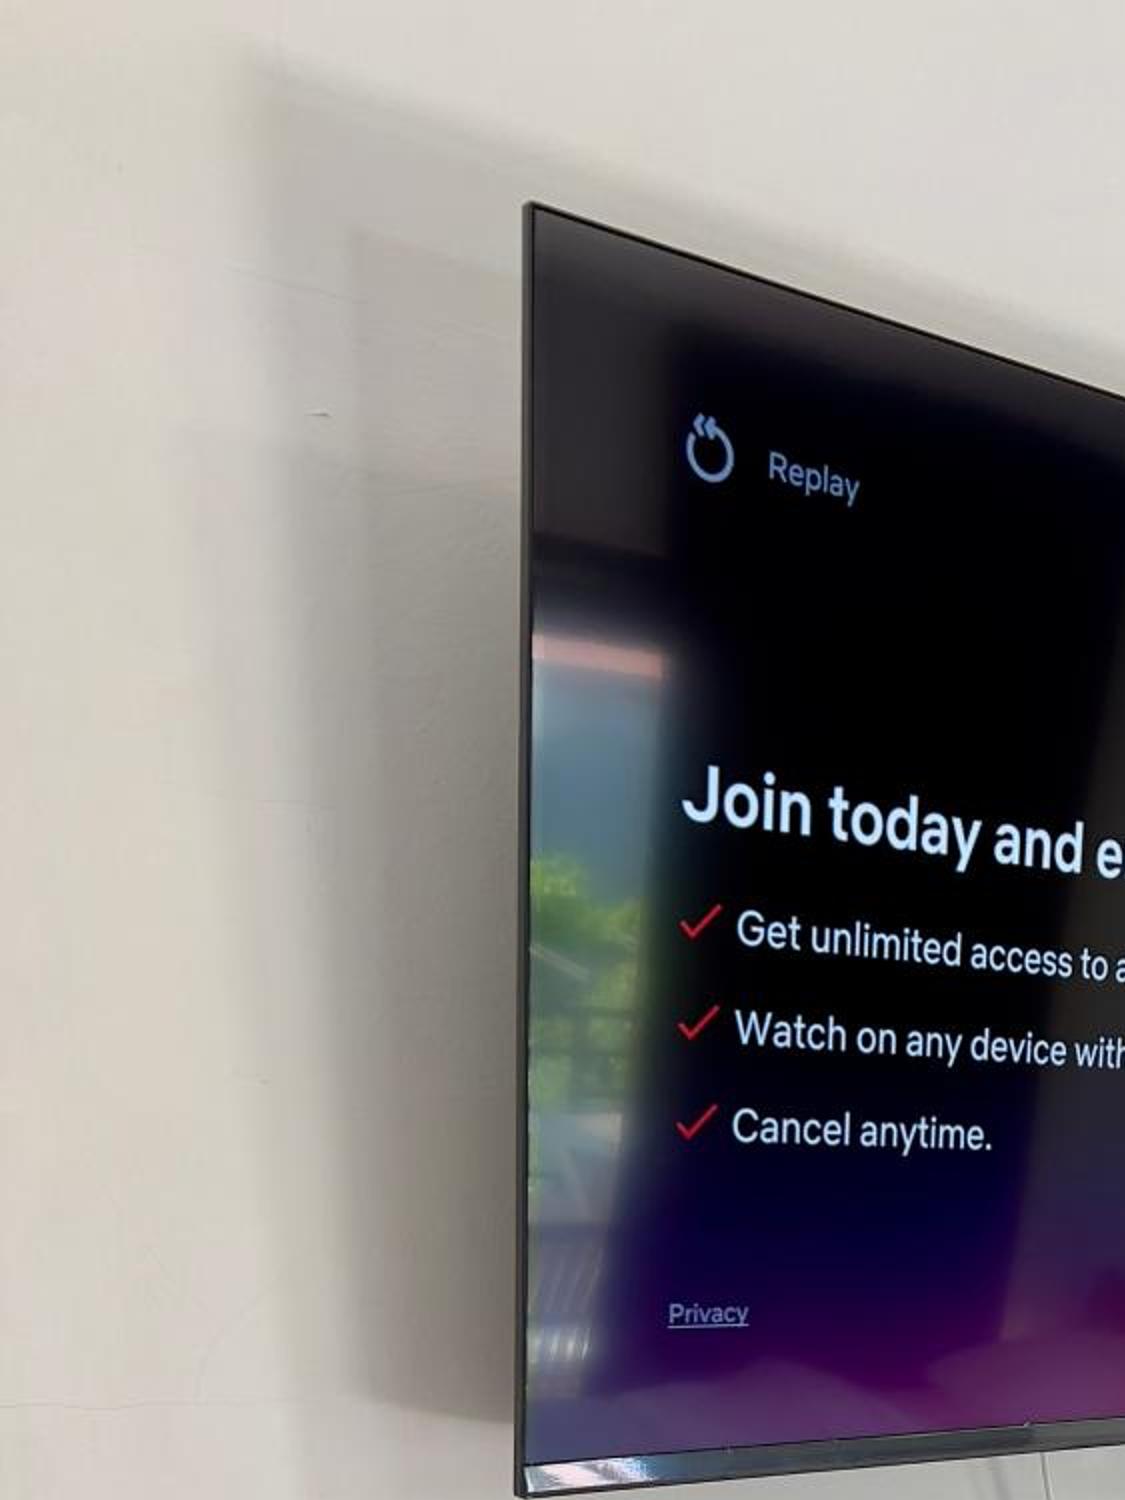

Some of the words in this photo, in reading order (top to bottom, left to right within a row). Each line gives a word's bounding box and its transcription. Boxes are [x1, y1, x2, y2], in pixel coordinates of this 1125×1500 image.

[767, 451, 860, 508] Replay
[682, 765, 811, 837] Join
[828, 786, 982, 873] today
[993, 822, 1084, 874] and
[736, 909, 801, 951] Get
[810, 921, 962, 967] unlimited
[970, 943, 1073, 979] access
[1080, 947, 1109, 982] to
[734, 1009, 847, 1053] Watch
[856, 1027, 897, 1055] on
[906, 1030, 963, 1068] any
[970, 1027, 1067, 1067] device
[731, 1107, 851, 1146] Cancel
[859, 1115, 993, 1157] anytime.
[668, 1303, 749, 1327] Privacy
